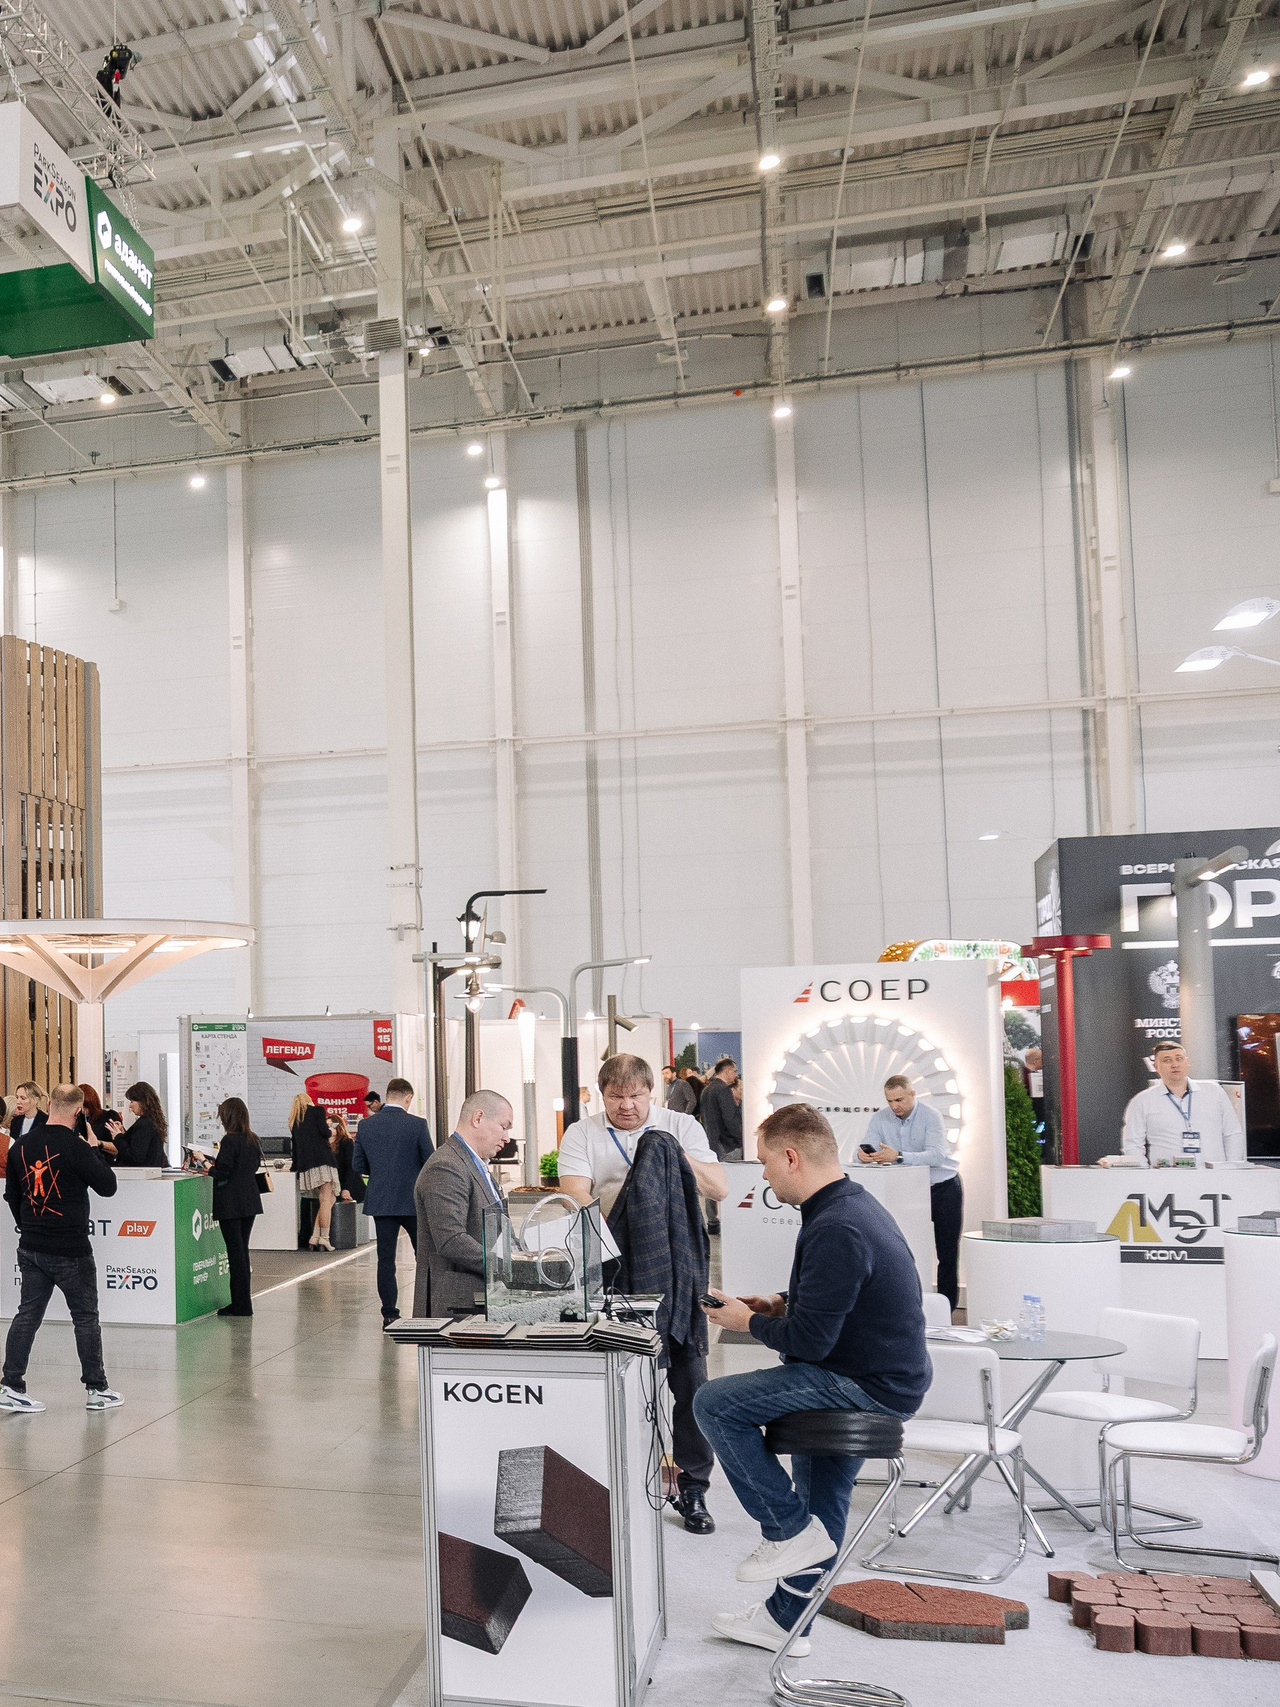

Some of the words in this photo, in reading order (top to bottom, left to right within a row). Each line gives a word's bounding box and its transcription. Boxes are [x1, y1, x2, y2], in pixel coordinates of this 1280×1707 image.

[33, 162, 77, 233] EXPO
[378, 1035, 390, 1043] 15
[266, 1045, 311, 1056] ЛЕГЕНДА
[317, 1097, 358, 1105] ВАННАТ
[126, 1223, 150, 1236] play
[106, 1275, 158, 1291] EXPO
[443, 1382, 543, 1405] KOGEN
